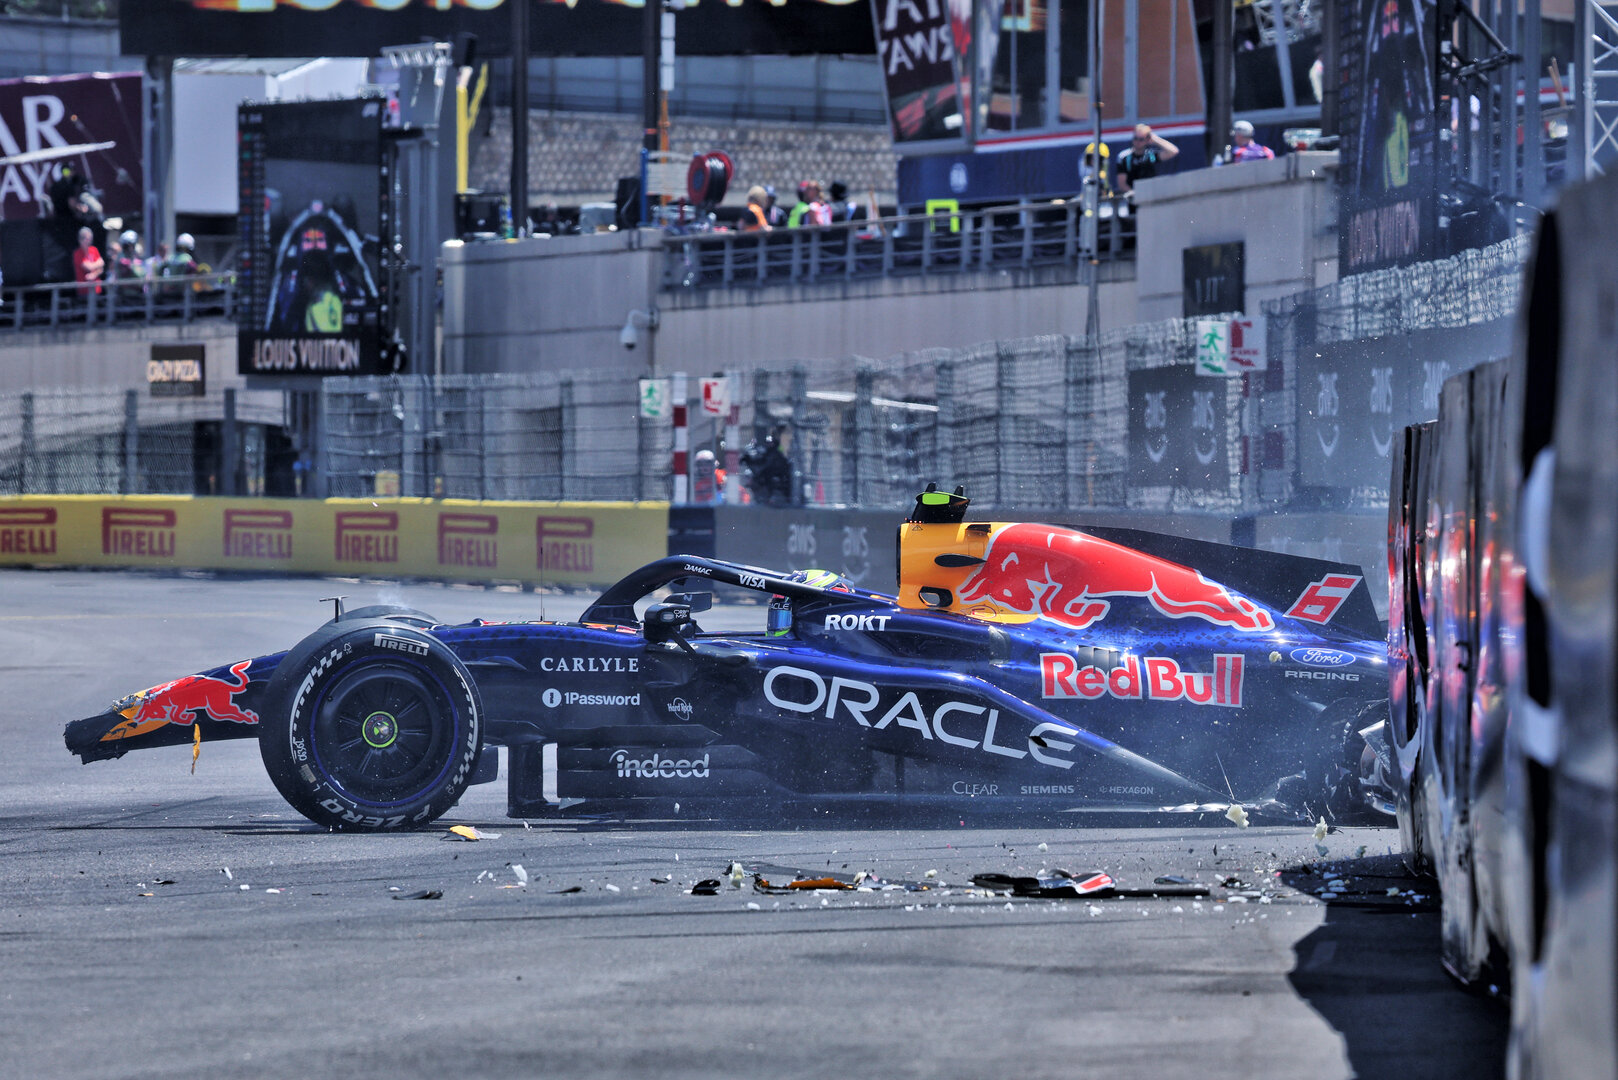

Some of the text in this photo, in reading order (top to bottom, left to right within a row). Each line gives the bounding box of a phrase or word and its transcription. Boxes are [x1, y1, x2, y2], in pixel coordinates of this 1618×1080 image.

[254, 338, 360, 370] LOUIS VUITTON
[102, 507, 176, 556] PIRELLI
[224, 509, 293, 559] PIRELLI
[335, 511, 398, 562] PIRELLI
[438, 512, 498, 568] PIRELLI
[536, 515, 594, 572] PIRELLI
[684, 564, 712, 575] DAMAC
[738, 574, 766, 589] VISA
[1283, 573, 1363, 625] 6
[824, 614, 891, 632] ROKT
[374, 633, 430, 656] PIRELLI
[540, 658, 639, 672] CARLYLE
[1302, 649, 1343, 664] Ford
[1040, 653, 1245, 707] Red Bull
[1285, 670, 1360, 681] RACING
[564, 692, 640, 706] 1Password
[763, 665, 1080, 769] ORACLE
[616, 753, 710, 778] indeed
[1021, 785, 1074, 794] SIEMENS
[1109, 786, 1153, 795] HEXAGON
[320, 799, 430, 828] P ZERO
